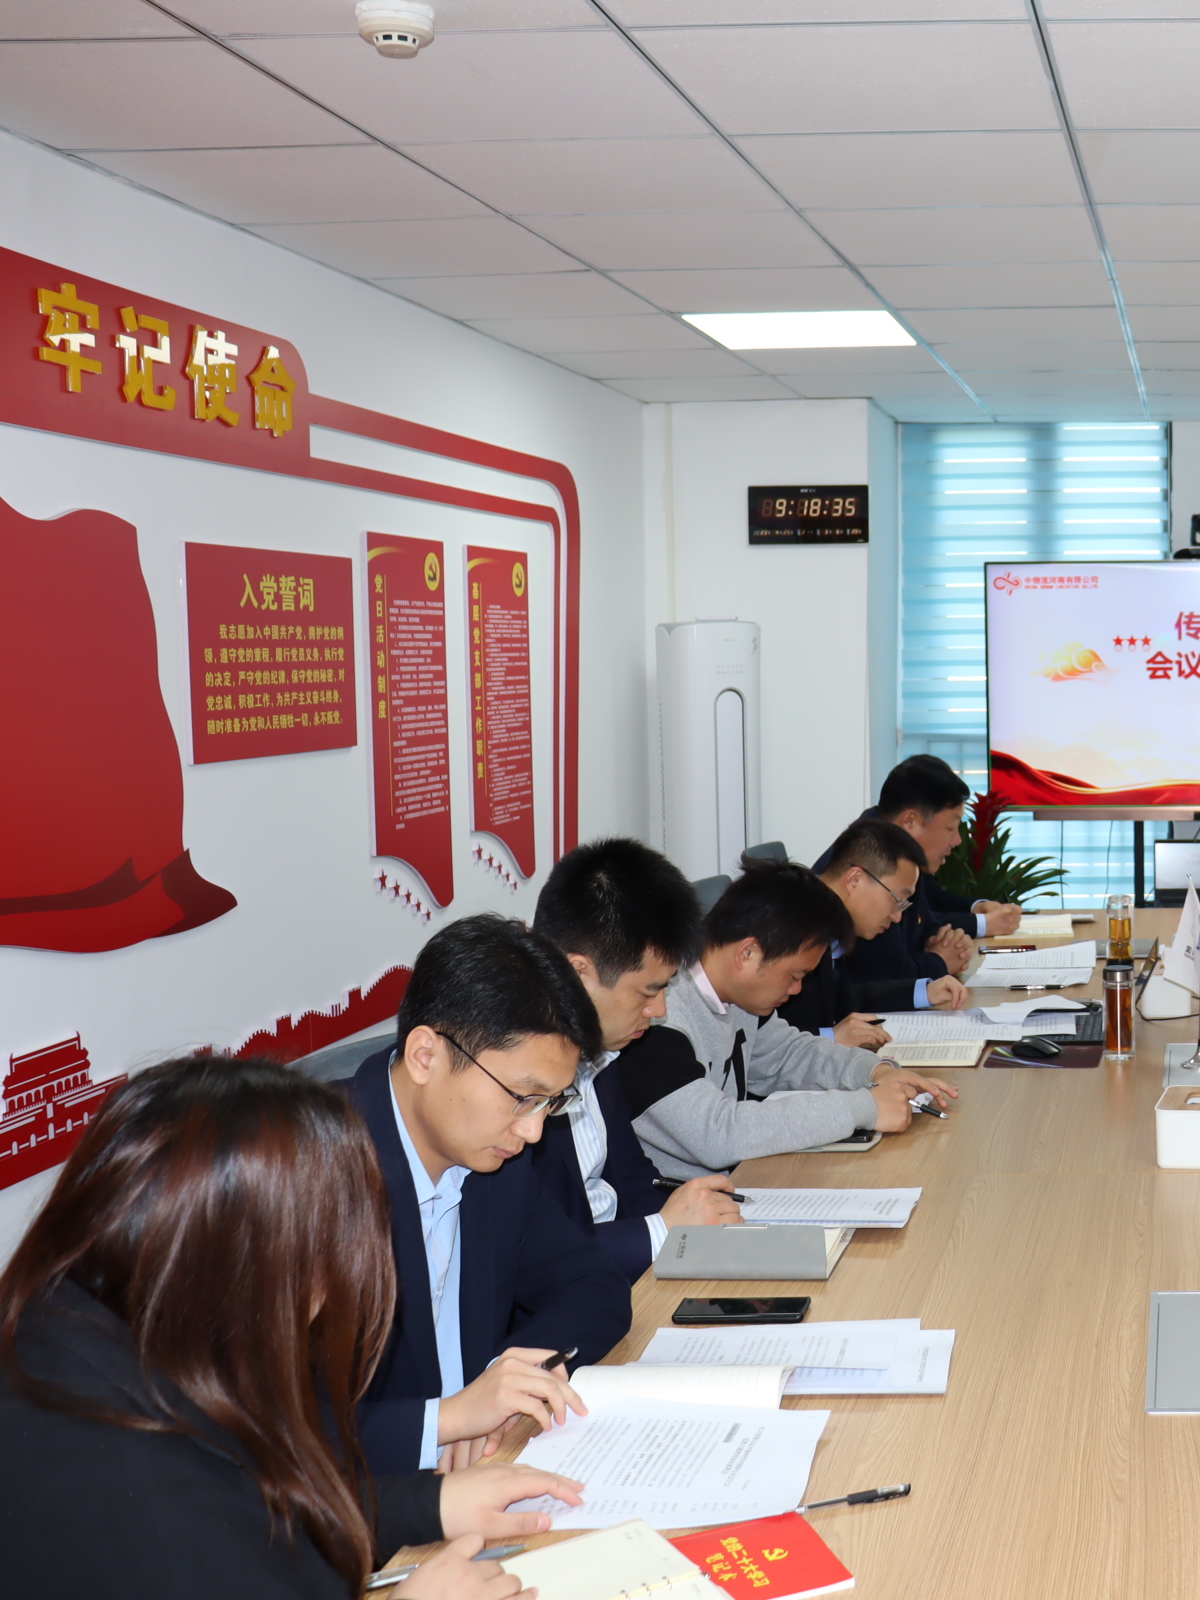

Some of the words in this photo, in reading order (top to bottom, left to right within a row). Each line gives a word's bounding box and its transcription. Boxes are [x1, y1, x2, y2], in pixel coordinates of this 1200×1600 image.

[38, 282, 297, 438] 牢记使命
[775, 498, 856, 517] 9:18:35
[239, 573, 315, 612] 入党誓词
[705, 1552, 738, 1582] 笔记本
[720, 1536, 771, 1588] 党的二十大学习
